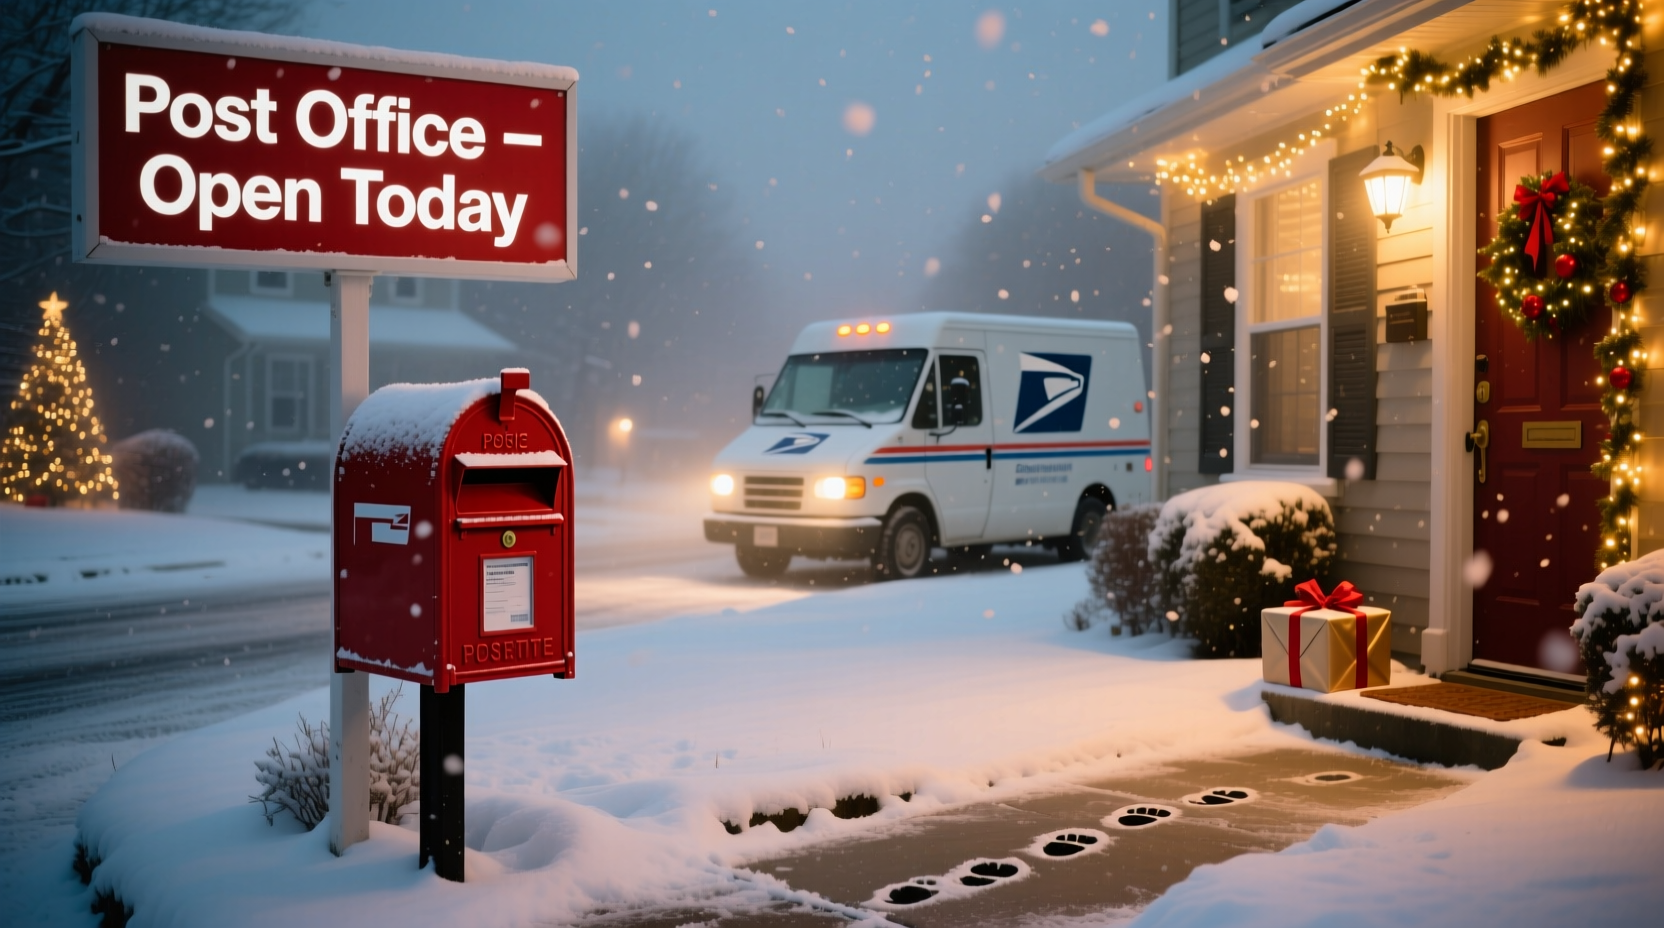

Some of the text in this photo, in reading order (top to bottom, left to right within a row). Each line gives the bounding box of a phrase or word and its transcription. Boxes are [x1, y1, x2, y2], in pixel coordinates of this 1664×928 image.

[125, 72, 278, 145] Post
[295, 89, 487, 160] Office
[139, 153, 529, 248] Open Today
